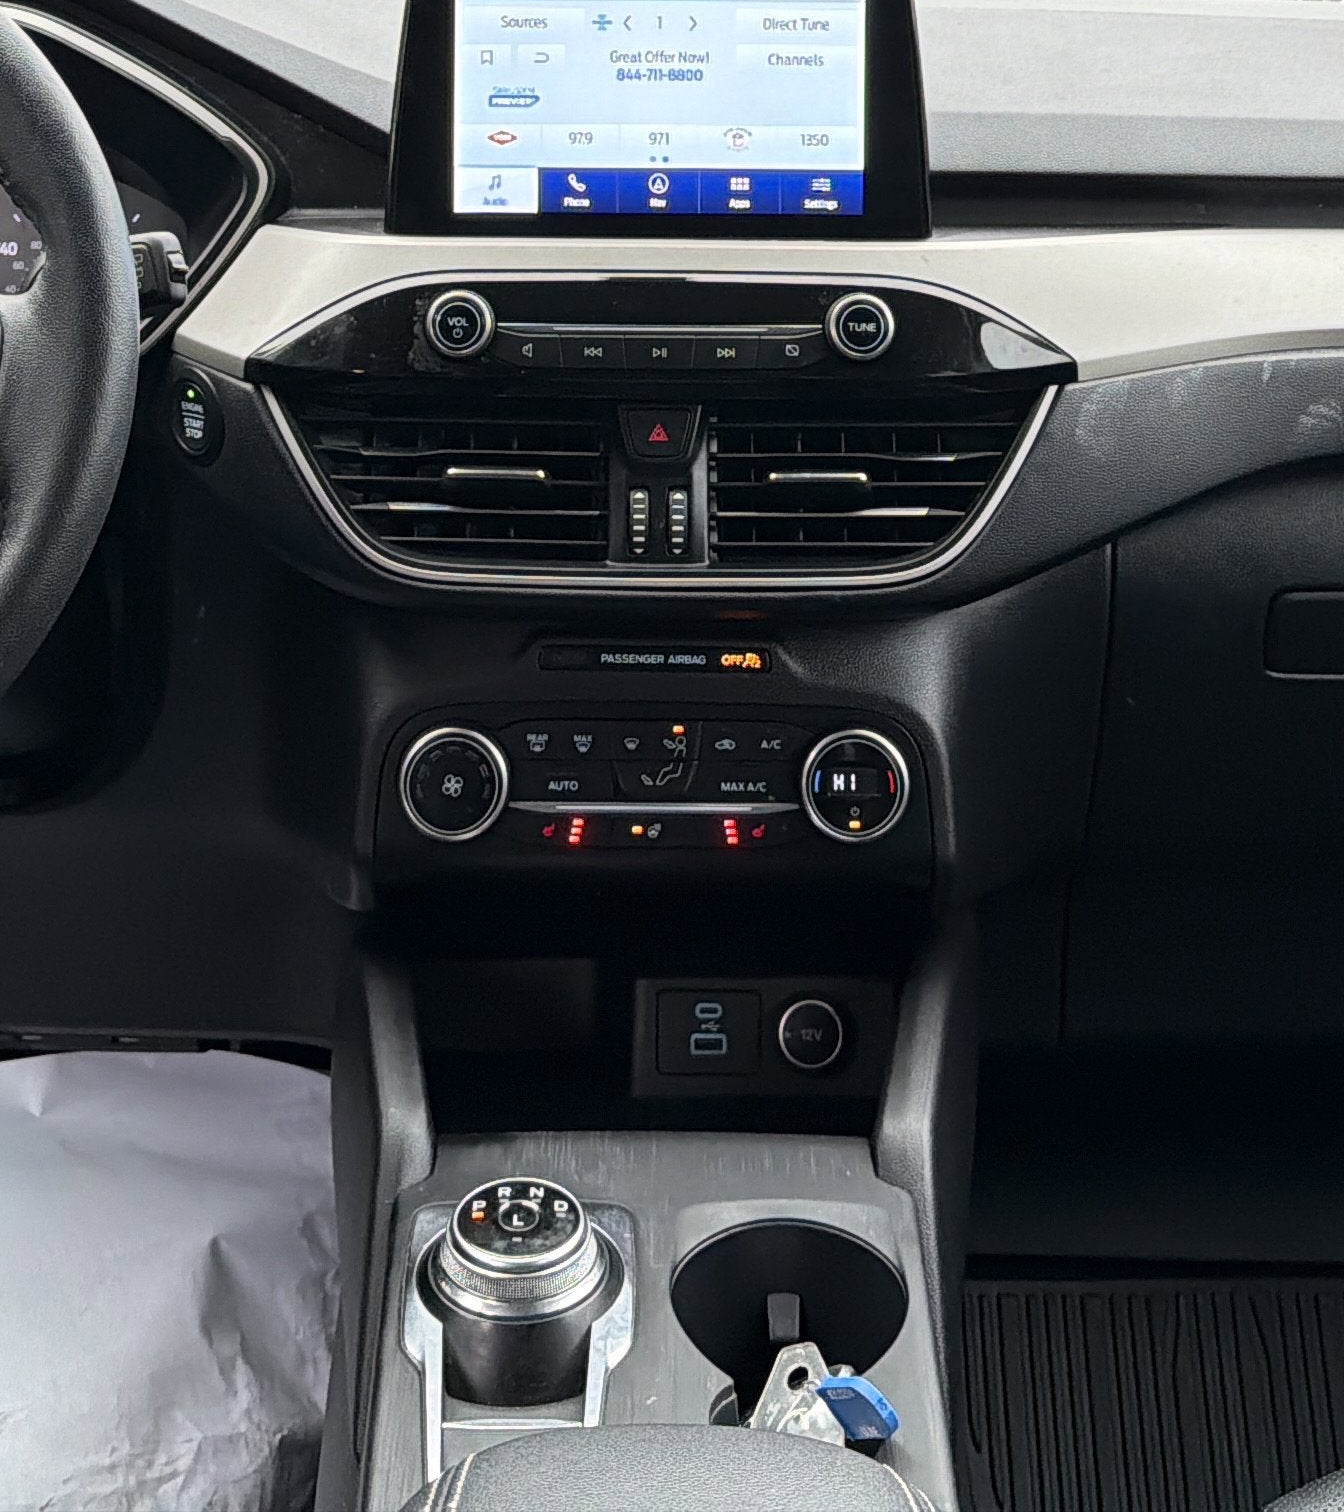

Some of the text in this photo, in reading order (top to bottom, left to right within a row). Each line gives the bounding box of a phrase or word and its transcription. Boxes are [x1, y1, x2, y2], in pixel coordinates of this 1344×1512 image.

[500, 14, 549, 30] Sources
[762, 17, 831, 32] Direct Tune
[609, 49, 642, 65] Great
[644, 49, 676, 65] Offer
[767, 52, 825, 67] Channels
[615, 67, 705, 83] 844-711-8800
[800, 133, 831, 148] 1350
[563, 196, 592, 209] Phone
[802, 198, 840, 212] Settings
[446, 316, 470, 327] VOL
[846, 321, 877, 333] TUNE
[185, 427, 204, 439] STOP
[600, 653, 743, 667] PASSENGER AIRBAG OFF
[526, 733, 549, 742] REAR
[573, 734, 593, 742] MAX
[760, 739, 782, 750] A/C
[547, 780, 579, 791] AUTO
[720, 781, 768, 793] MAX A/C
[832, 773, 857, 792] HI
[800, 1028, 824, 1042] 12V
[497, 1186, 513, 1199] R
[529, 1186, 545, 1198] N
[472, 1199, 487, 1211] P
[553, 1199, 569, 1212] D
[511, 1213, 525, 1227] L
